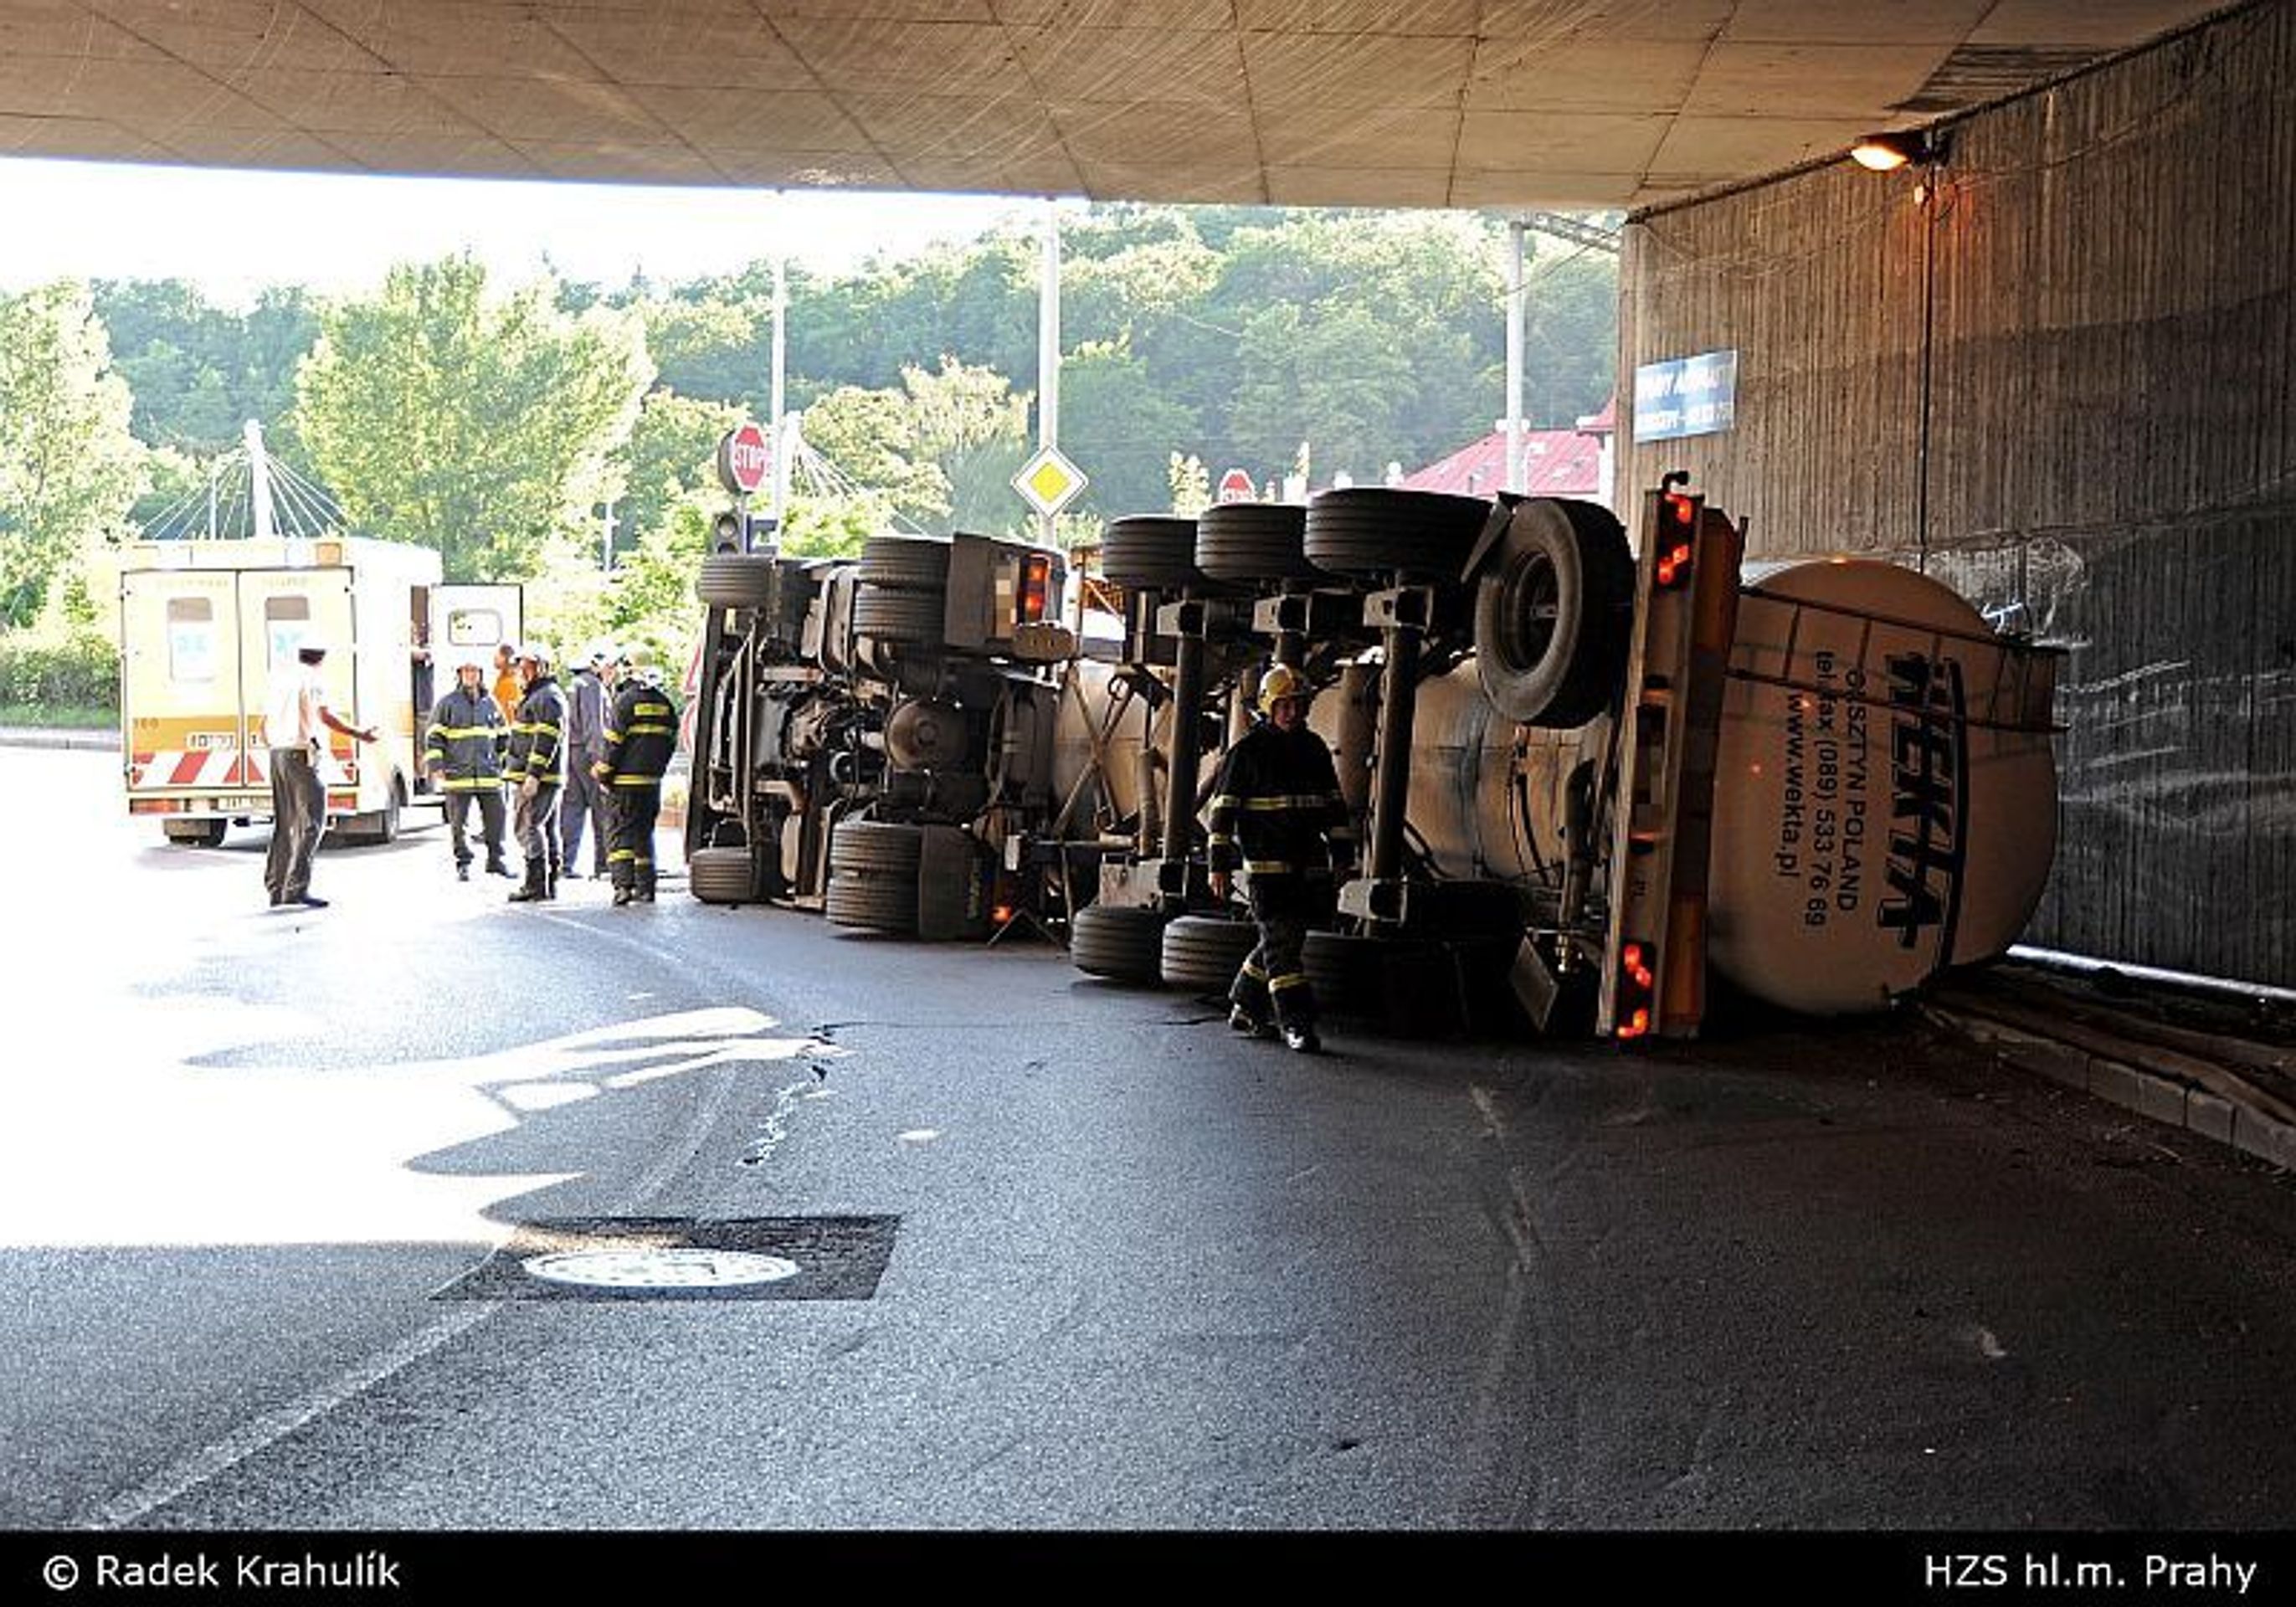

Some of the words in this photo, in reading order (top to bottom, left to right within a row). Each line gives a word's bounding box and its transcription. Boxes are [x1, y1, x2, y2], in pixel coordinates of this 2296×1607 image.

[734, 444, 765, 470] STOP
[1775, 693, 1805, 877] www.wekta.pl
[1816, 737, 1838, 804] (089)
[1813, 809, 1835, 852] 533
[1810, 860, 1831, 888] 76
[1836, 798, 1867, 912] POLAND
[1805, 896, 1826, 927] 69
